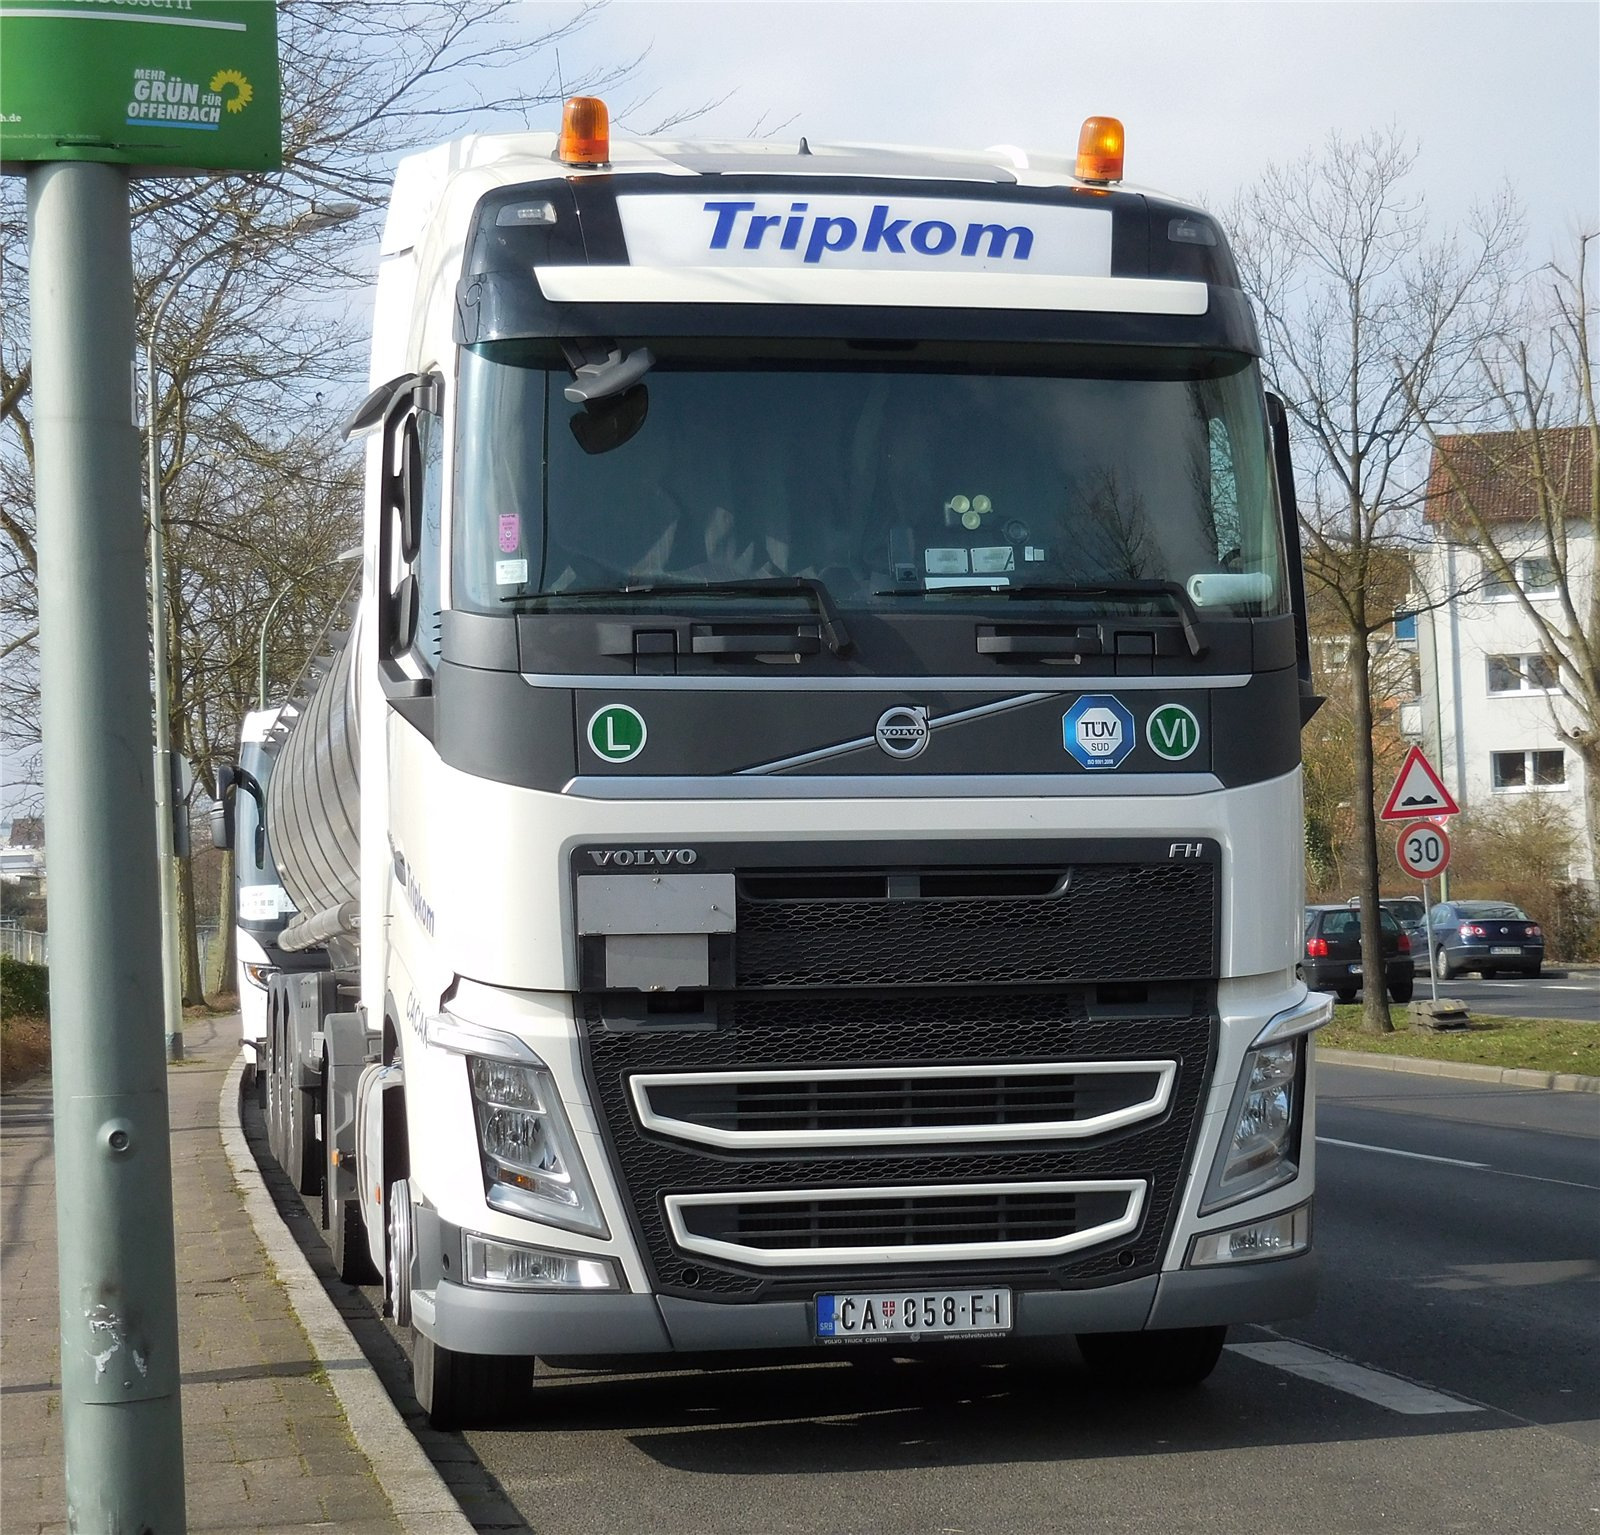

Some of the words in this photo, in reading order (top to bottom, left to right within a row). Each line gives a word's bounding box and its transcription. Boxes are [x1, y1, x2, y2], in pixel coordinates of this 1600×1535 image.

[134, 68, 166, 80] MEHR
[134, 77, 199, 104] GRÜN
[201, 93, 222, 106] FÜR
[127, 101, 221, 123] OFFENBACH
[703, 200, 1035, 264] Tripkom
[606, 716, 631, 751] L
[878, 727, 925, 737] VOLVO
[1081, 721, 1117, 738] TÜV
[1156, 718, 1188, 748] VI
[1091, 742, 1110, 752] SÜD
[587, 849, 698, 866] VOLVO
[1168, 843, 1203, 858] FH
[1407, 836, 1440, 864] 30
[407, 861, 435, 937] Tripkom
[819, 1322, 833, 1331] SRB
[865, 1336, 888, 1344] CENTER
